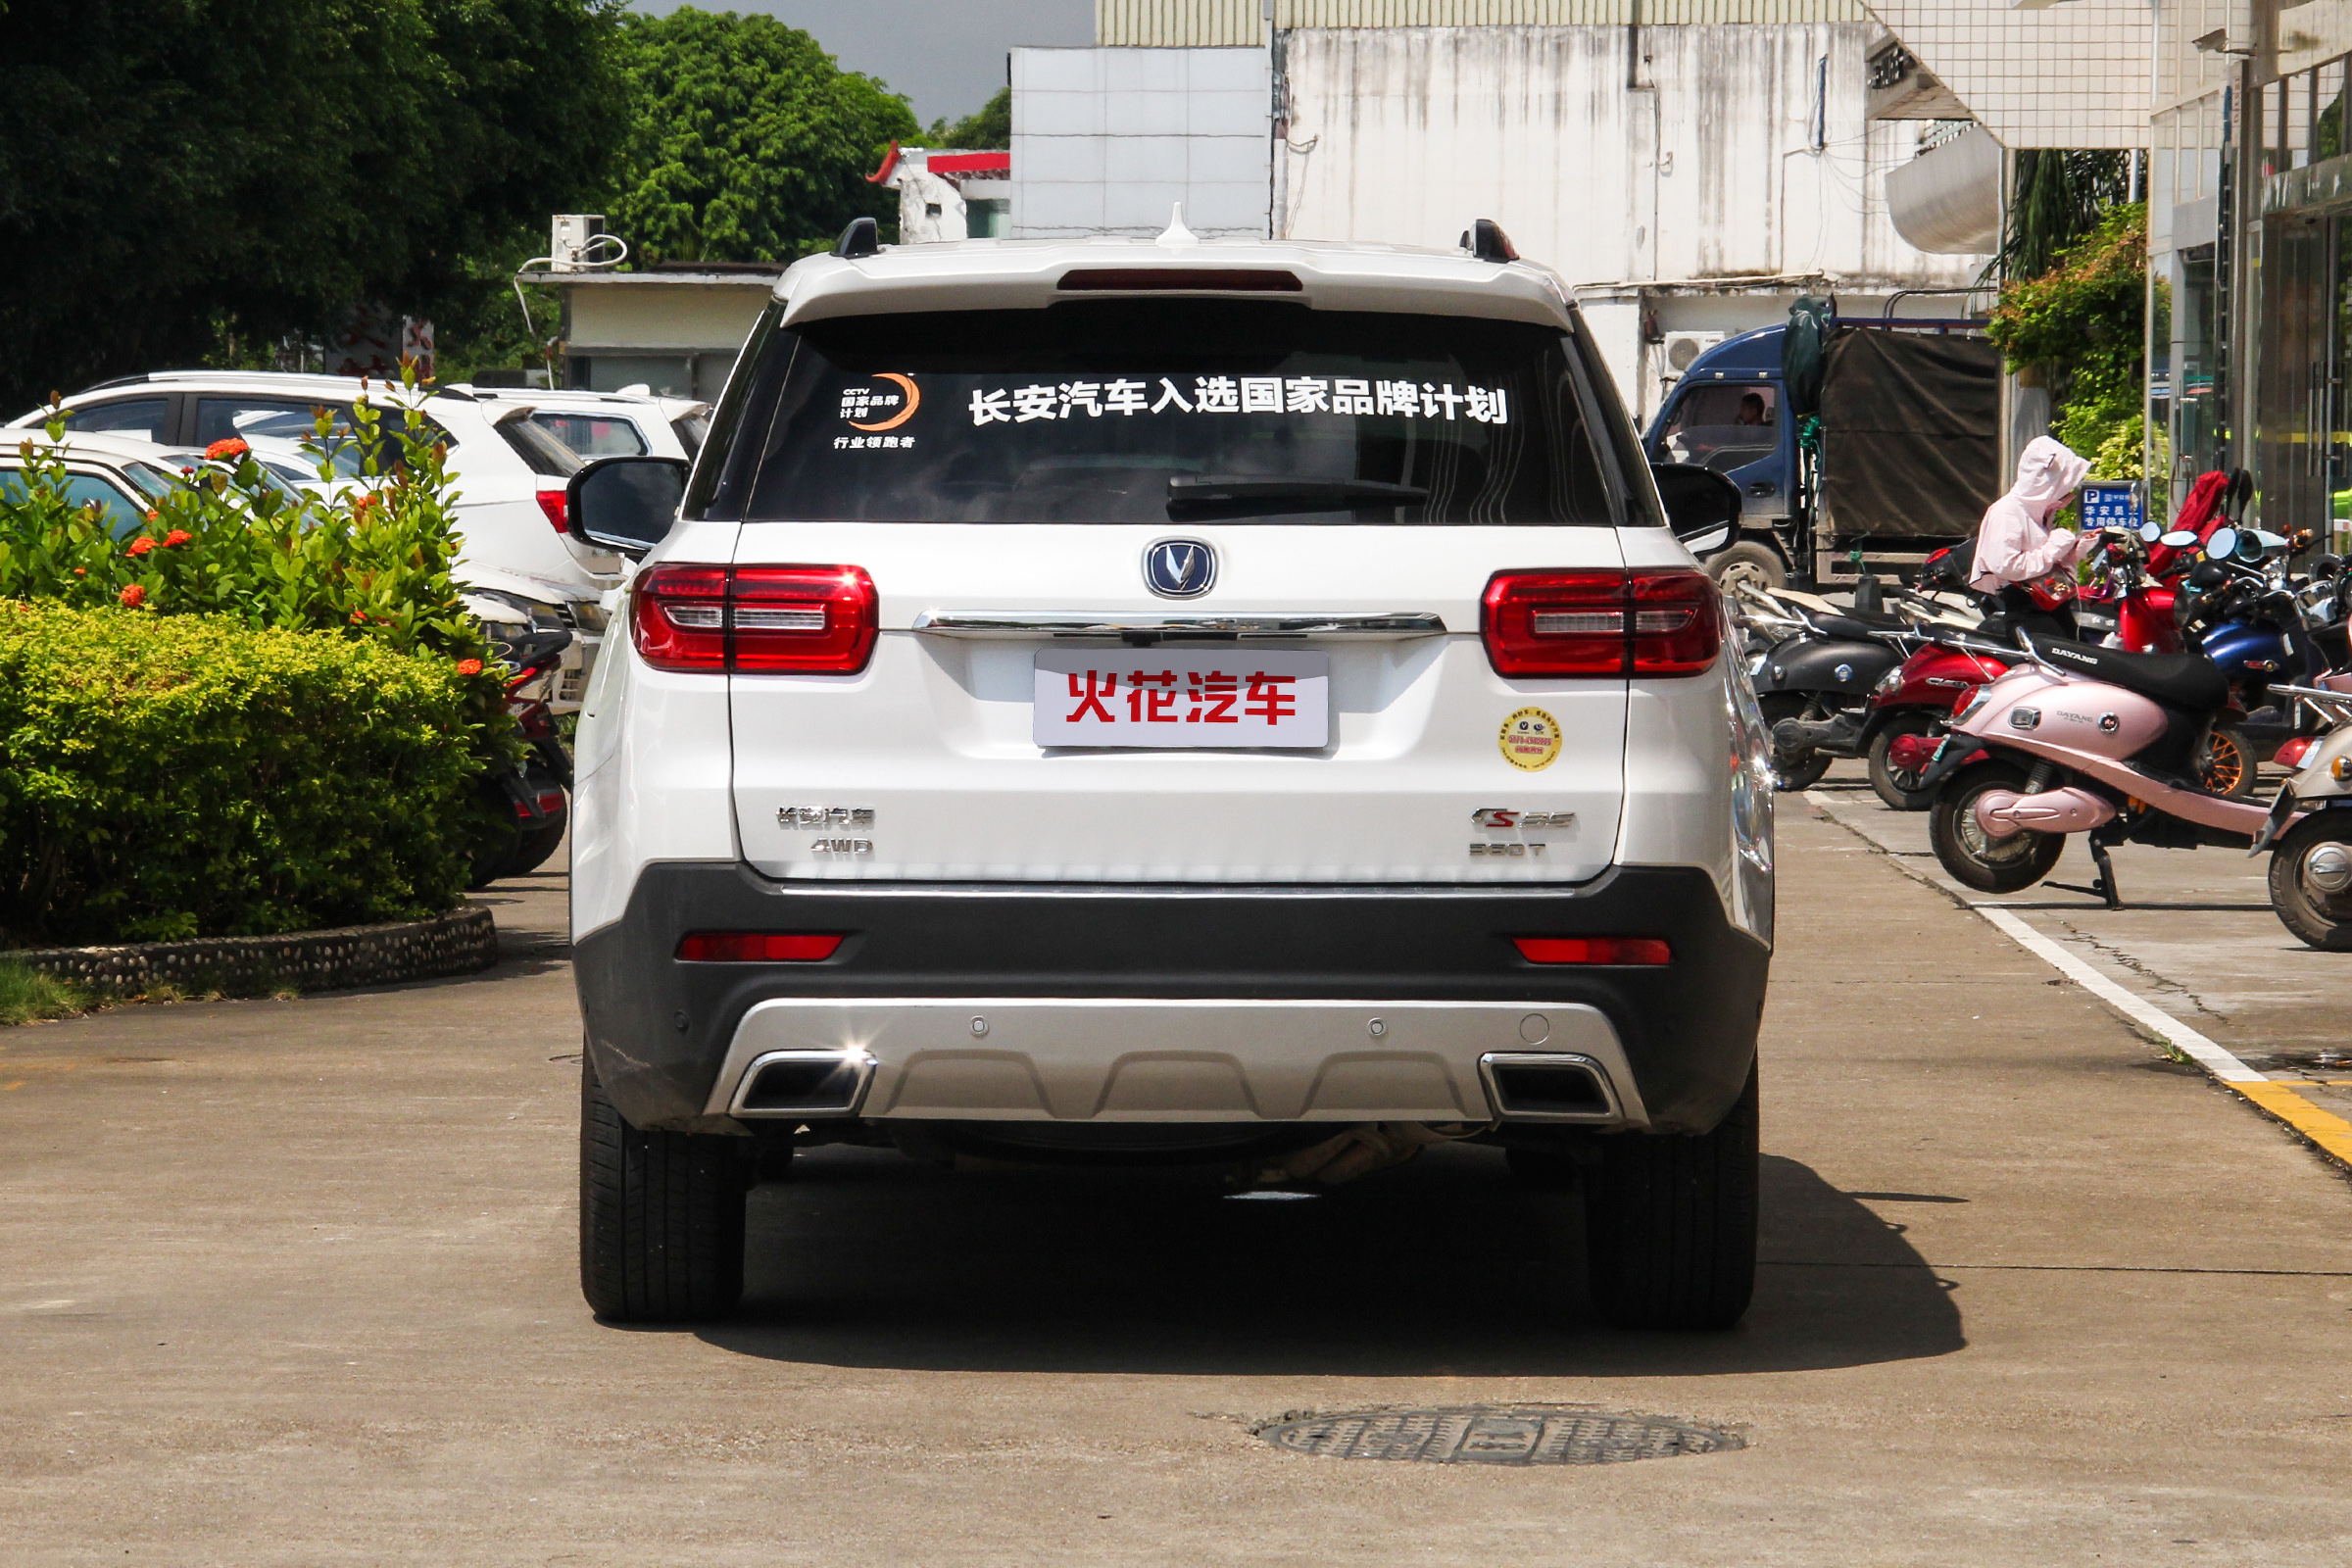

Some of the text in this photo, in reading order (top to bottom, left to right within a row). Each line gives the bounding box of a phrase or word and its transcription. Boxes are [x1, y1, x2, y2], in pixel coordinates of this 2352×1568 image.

[841, 395, 899, 407] 国家品牌
[969, 376, 1508, 426] 长安汽车入选国家品牌计划
[840, 407, 868, 418] 计划
[833, 436, 915, 449] 行业领跑者
[2051, 647, 2098, 665] DAYANG
[1066, 669, 1296, 725] 火花汽车
[2056, 710, 2093, 723] DAYANG
[810, 837, 873, 854] 4WD
